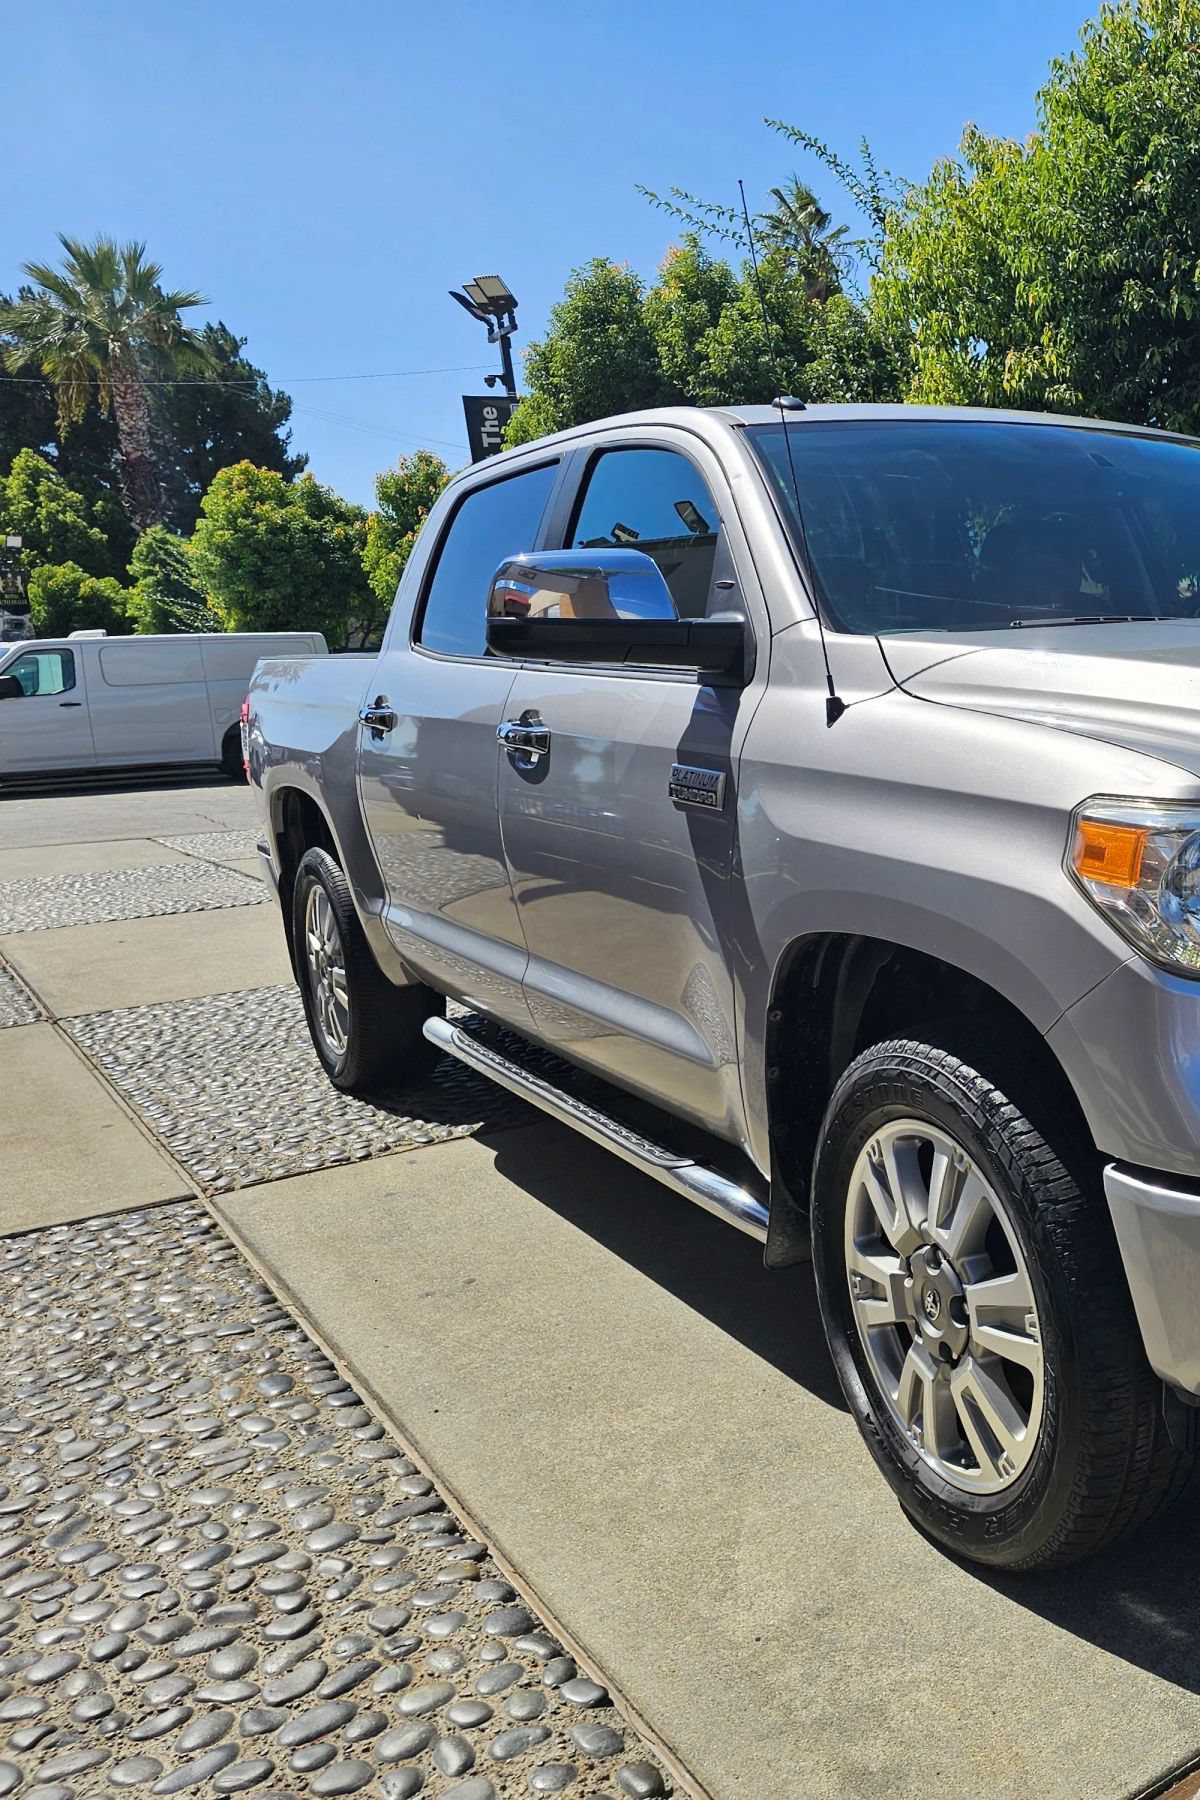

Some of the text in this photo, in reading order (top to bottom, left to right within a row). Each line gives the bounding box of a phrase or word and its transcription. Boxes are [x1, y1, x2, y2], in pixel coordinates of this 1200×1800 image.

[481, 406, 501, 448] The
[672, 768, 719, 788] PLATINUM
[670, 784, 716, 805] TUNDRA
